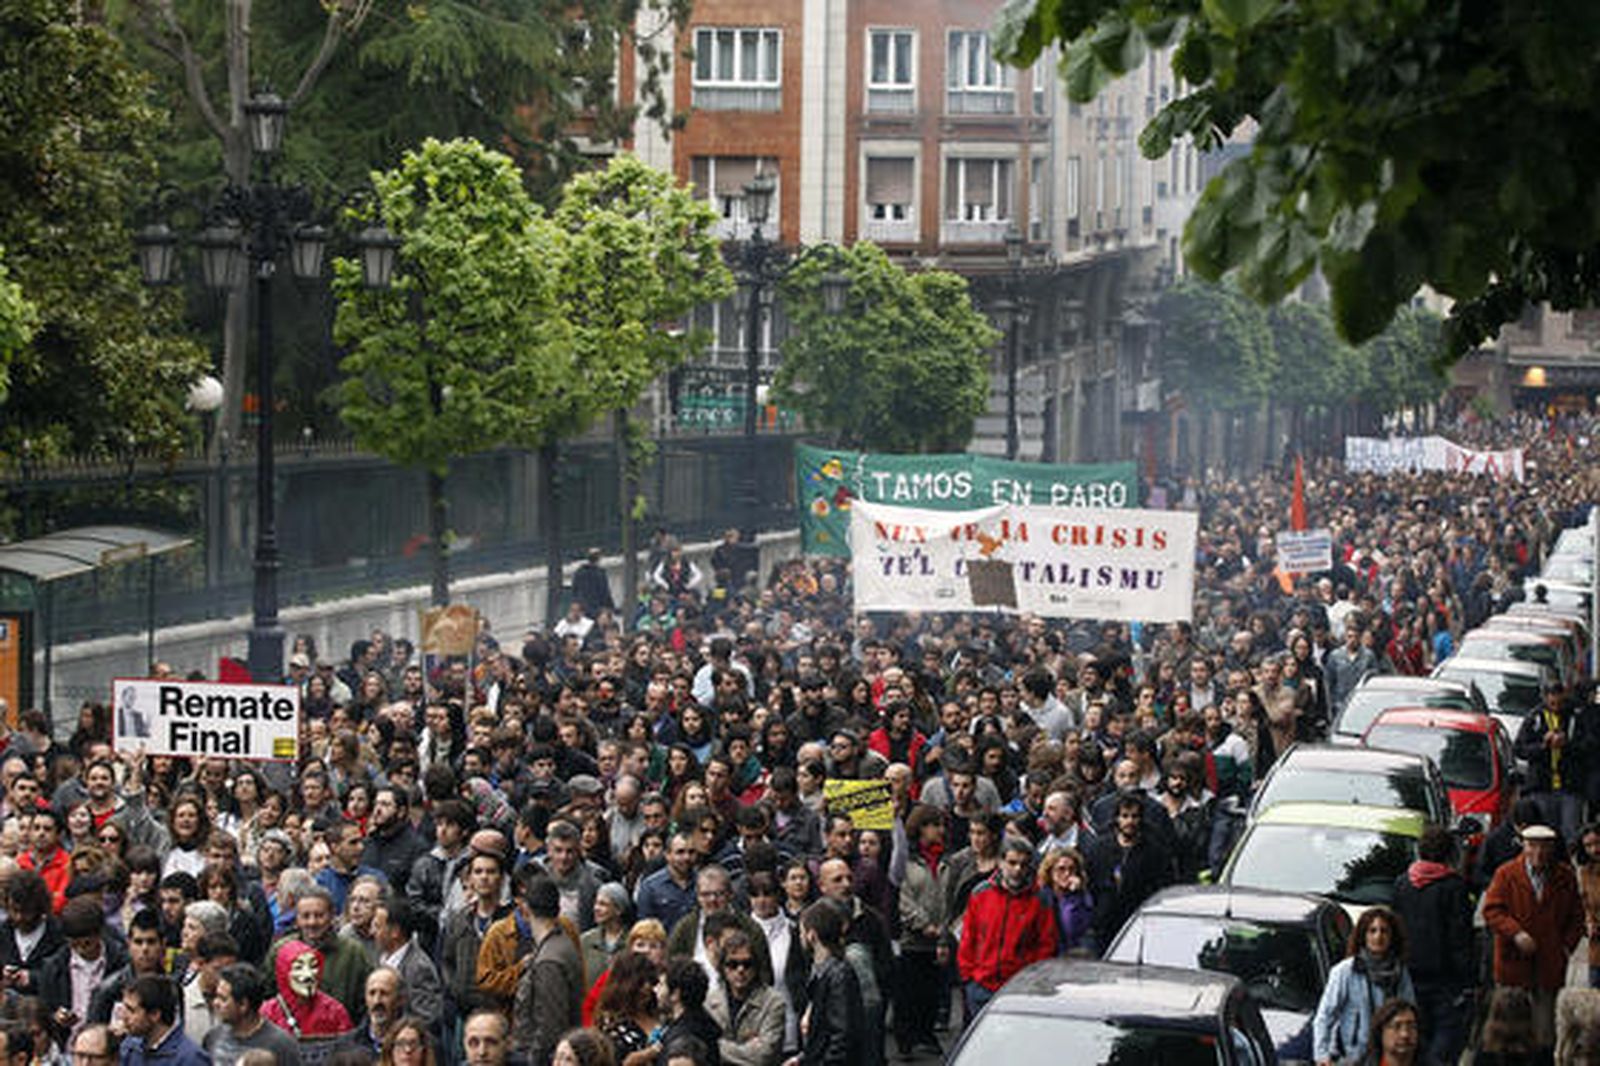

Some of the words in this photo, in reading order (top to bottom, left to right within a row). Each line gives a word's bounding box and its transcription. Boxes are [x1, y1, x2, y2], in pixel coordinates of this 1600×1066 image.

[871, 471, 973, 500] TAMOS
[991, 478, 1033, 507] EN
[1050, 481, 1128, 509] PARO
[1051, 523, 1168, 550] CRISIS
[955, 557, 1164, 591] CTALISMU
[159, 686, 295, 721] Remate
[170, 722, 250, 755] Final
